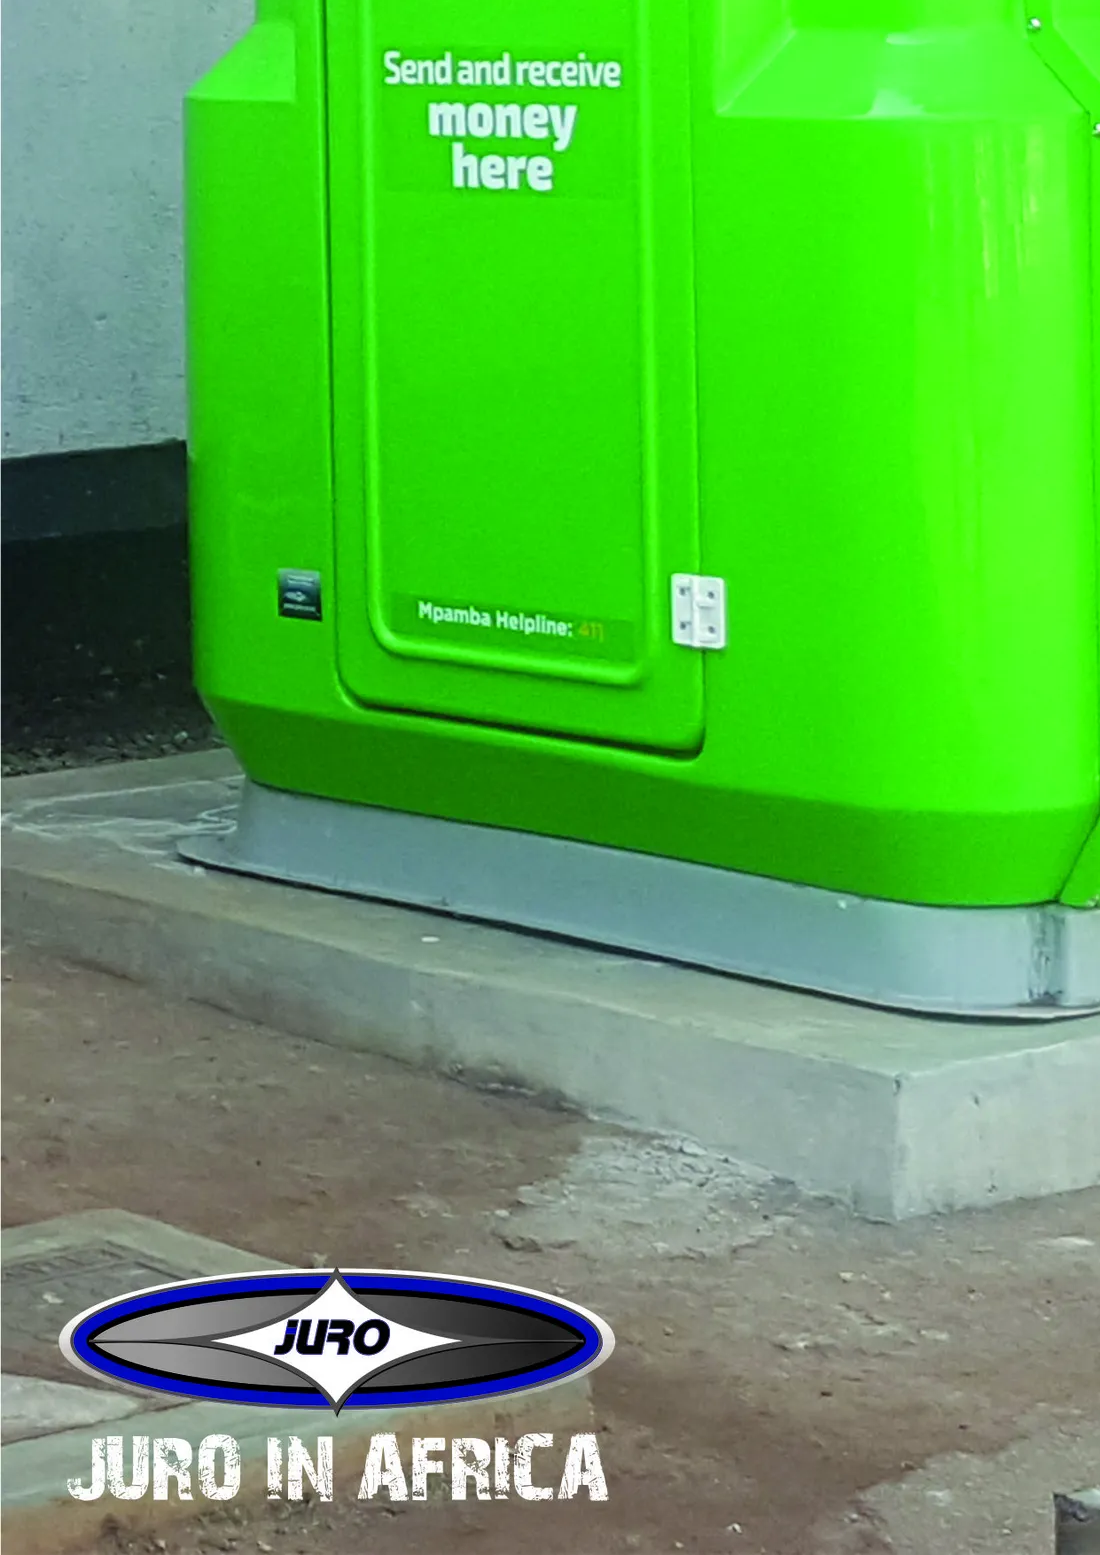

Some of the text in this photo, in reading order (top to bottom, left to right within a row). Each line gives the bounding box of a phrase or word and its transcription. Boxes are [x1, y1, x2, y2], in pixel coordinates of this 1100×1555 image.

[384, 50, 621, 87] Send and receive
[428, 101, 578, 152] money
[452, 142, 554, 191] here
[418, 601, 491, 627] Mpamba
[496, 611, 573, 637] Helpline:
